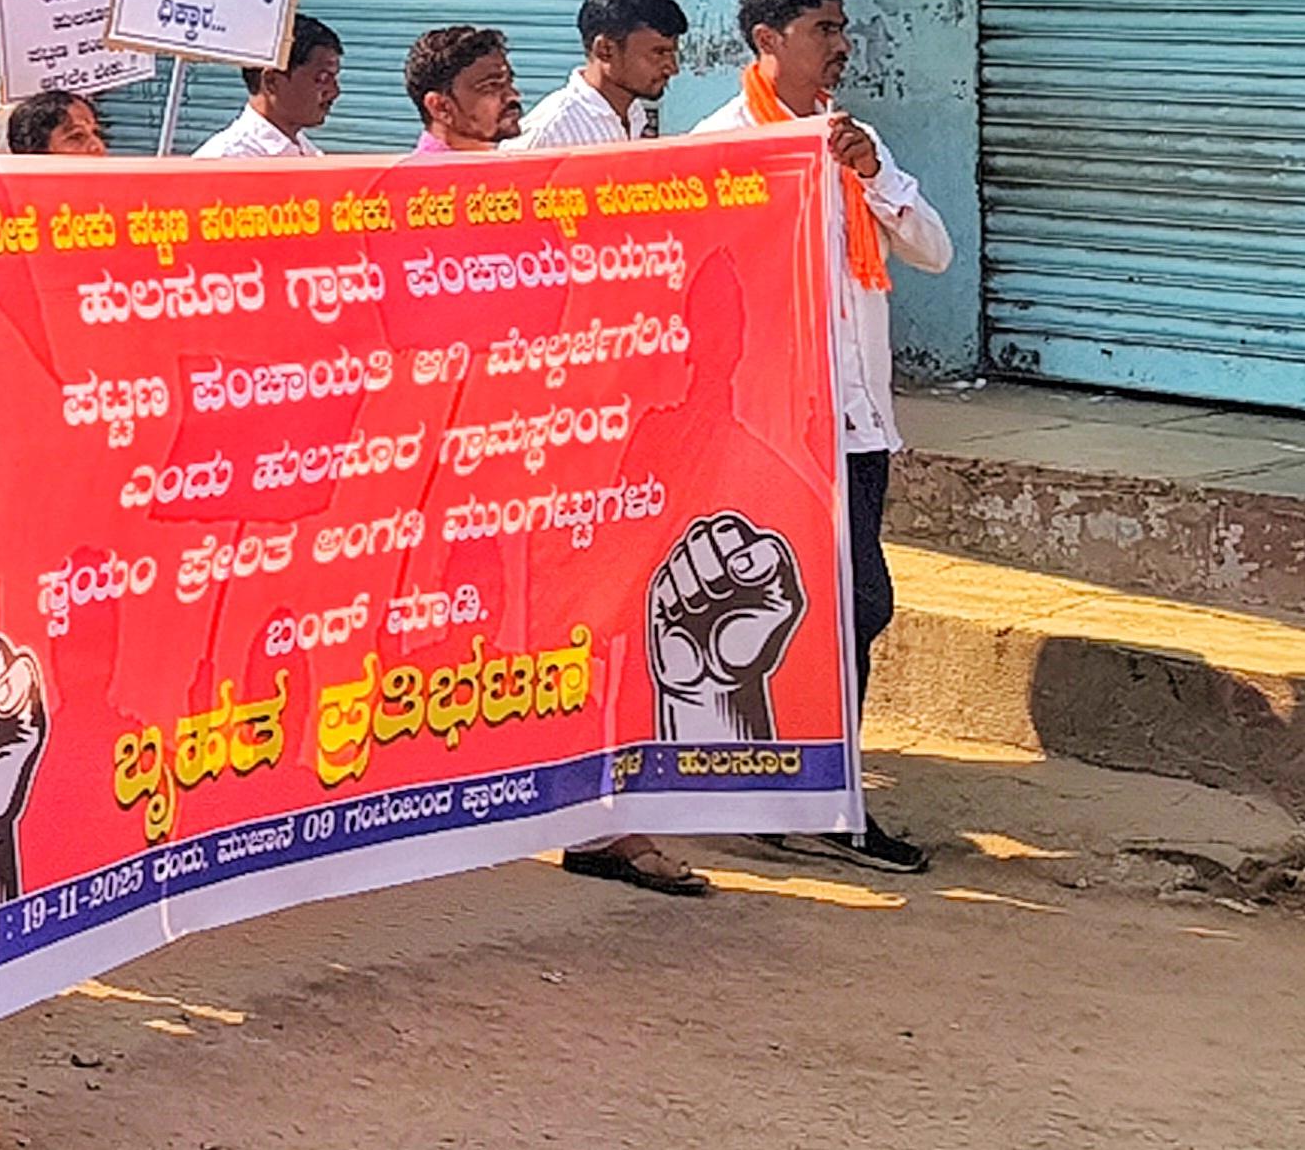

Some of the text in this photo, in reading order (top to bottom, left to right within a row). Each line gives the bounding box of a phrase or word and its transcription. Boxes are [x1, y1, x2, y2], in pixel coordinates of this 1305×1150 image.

[49, 201, 117, 250] ಬೇಕು
[126, 201, 190, 267] ಪಟ್ಟಣ
[199, 195, 322, 243] ಪಂಚಾಯತಿ
[404, 183, 458, 229] ಬೇಕೆ
[464, 181, 523, 225] ಬೇಕು
[531, 178, 589, 239] ಪಟ್ಟಣ
[594, 171, 710, 218] ಪಂಚಾಯತಿ
[77, 229, 687, 326] ಹುಲಸೂರ ಗ್ರಾಮ ಪಂಚಾಯತಿಯನ್ನು
[61, 368, 171, 450] ಪಟ್ಟಣ
[189, 343, 394, 414] ಪಂಚಾಯತಿ
[410, 341, 472, 387] ಆಗಿ
[118, 392, 632, 510] ಎಂದು ಹುಲಸೂರ ಗ್ರಾಮಸ್ಥರಿಂದ
[36, 471, 667, 639] ಸ್ವಯಂ ಪ್ರೇರಿತ ಅಂಗಡಿ ಮುಂಗಟ್ಟುಗಳು
[264, 582, 490, 658] ಬಂದ್ ಮಾಡಿ.
[111, 668, 290, 843] ಬೃಹತ
[656, 751, 665, 775] :
[675, 745, 804, 776] ಹುಲಸೂರ
[5, 912, 14, 942] :
[20, 860, 145, 936] 19-11-2025
[215, 816, 296, 865] ಮುಜಾನೆ
[302, 808, 336, 843] 09
[342, 784, 455, 835] ಗಂಟೆಯಿಂದ
